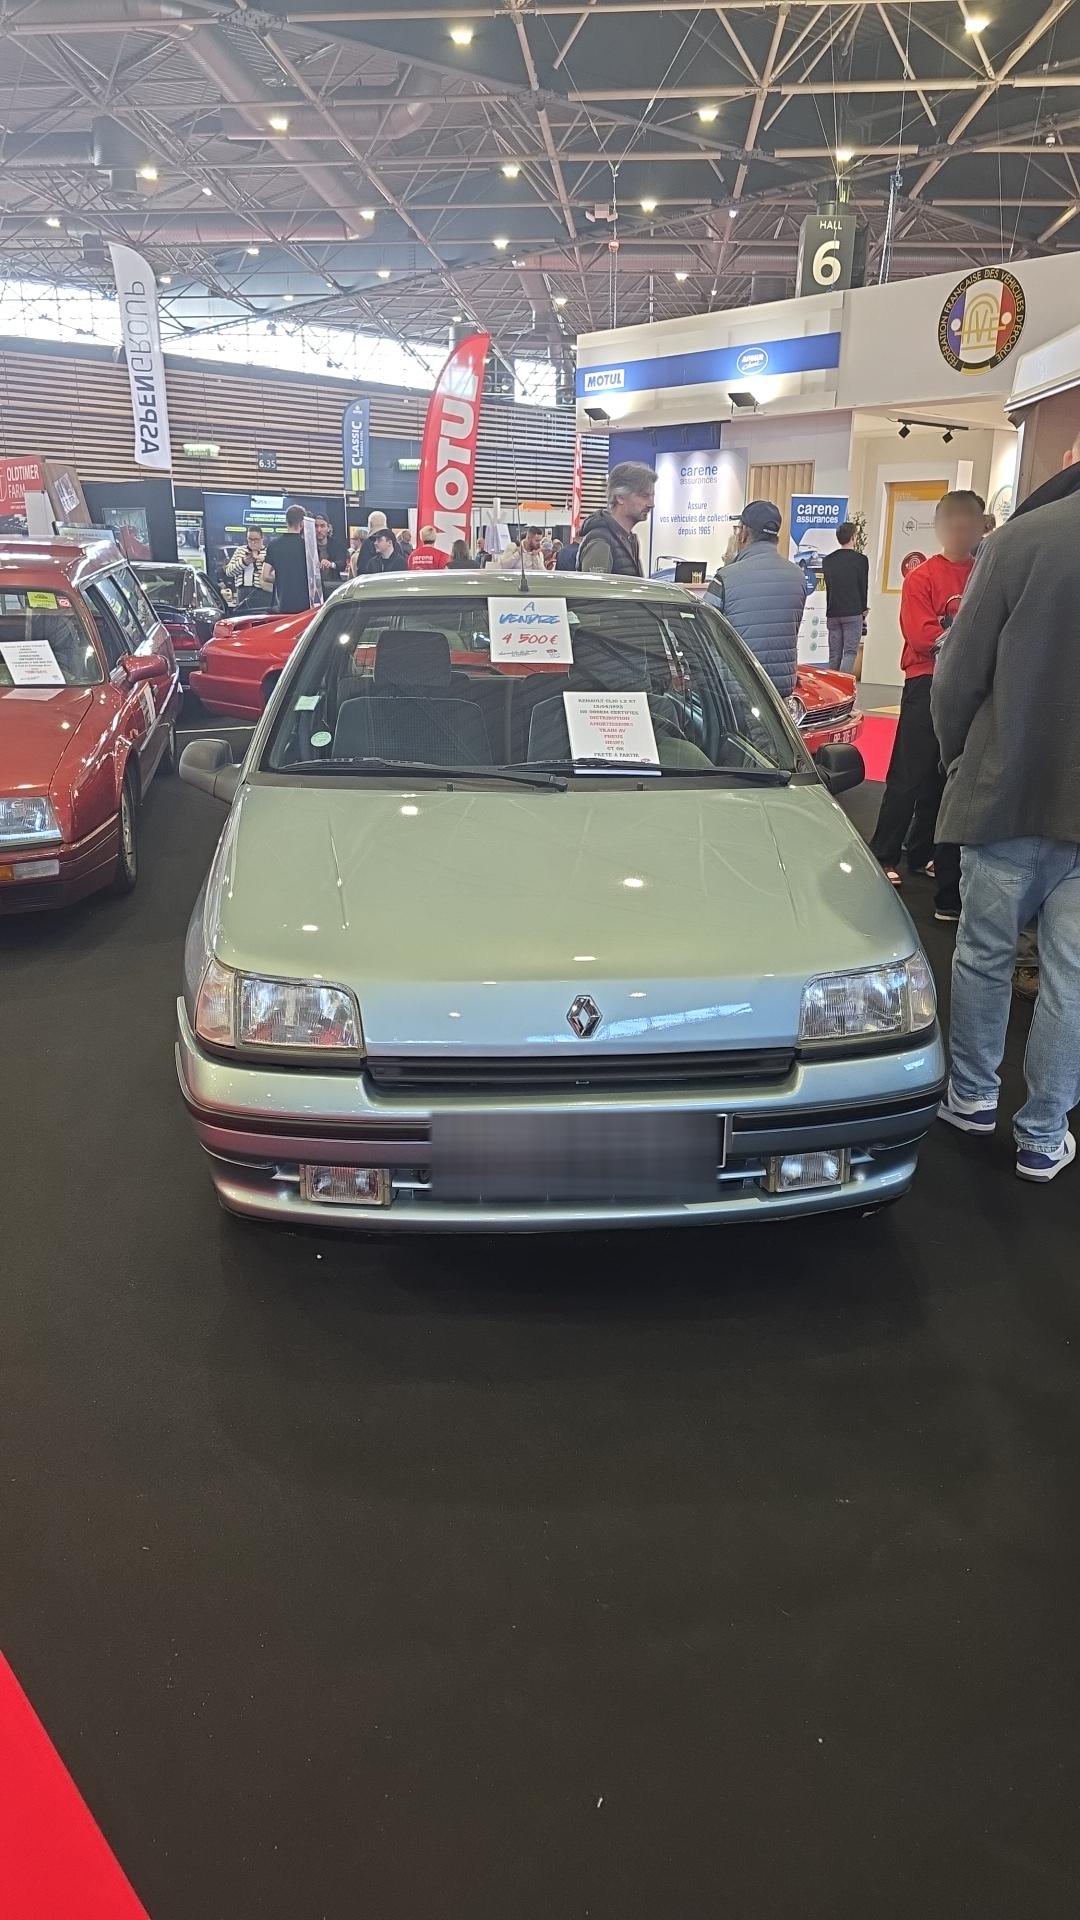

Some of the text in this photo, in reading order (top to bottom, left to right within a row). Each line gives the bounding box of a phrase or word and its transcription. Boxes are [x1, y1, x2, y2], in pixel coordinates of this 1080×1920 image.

[820, 220, 842, 230] HALL
[813, 240, 841, 286] 6
[984, 268, 1000, 279] DES
[587, 373, 622, 388] MOTUL
[351, 420, 363, 466] CLASSIC
[259, 460, 276, 469] 6.35
[433, 375, 479, 555] MOTUL
[6, 464, 40, 482] OLDTIMER
[680, 465, 718, 477] carene
[679, 477, 718, 486] assurances
[7, 483, 26, 499] FARM
[687, 500, 708, 510] Assure
[796, 503, 840, 515] carene
[659, 515, 670, 523] vos
[670, 513, 698, 523] véhicules
[698, 513, 706, 523] de
[796, 514, 839, 524] assurances
[677, 526, 697, 537] depuis
[698, 525, 711, 535] 1965
[502, 633, 513, 644] 4
